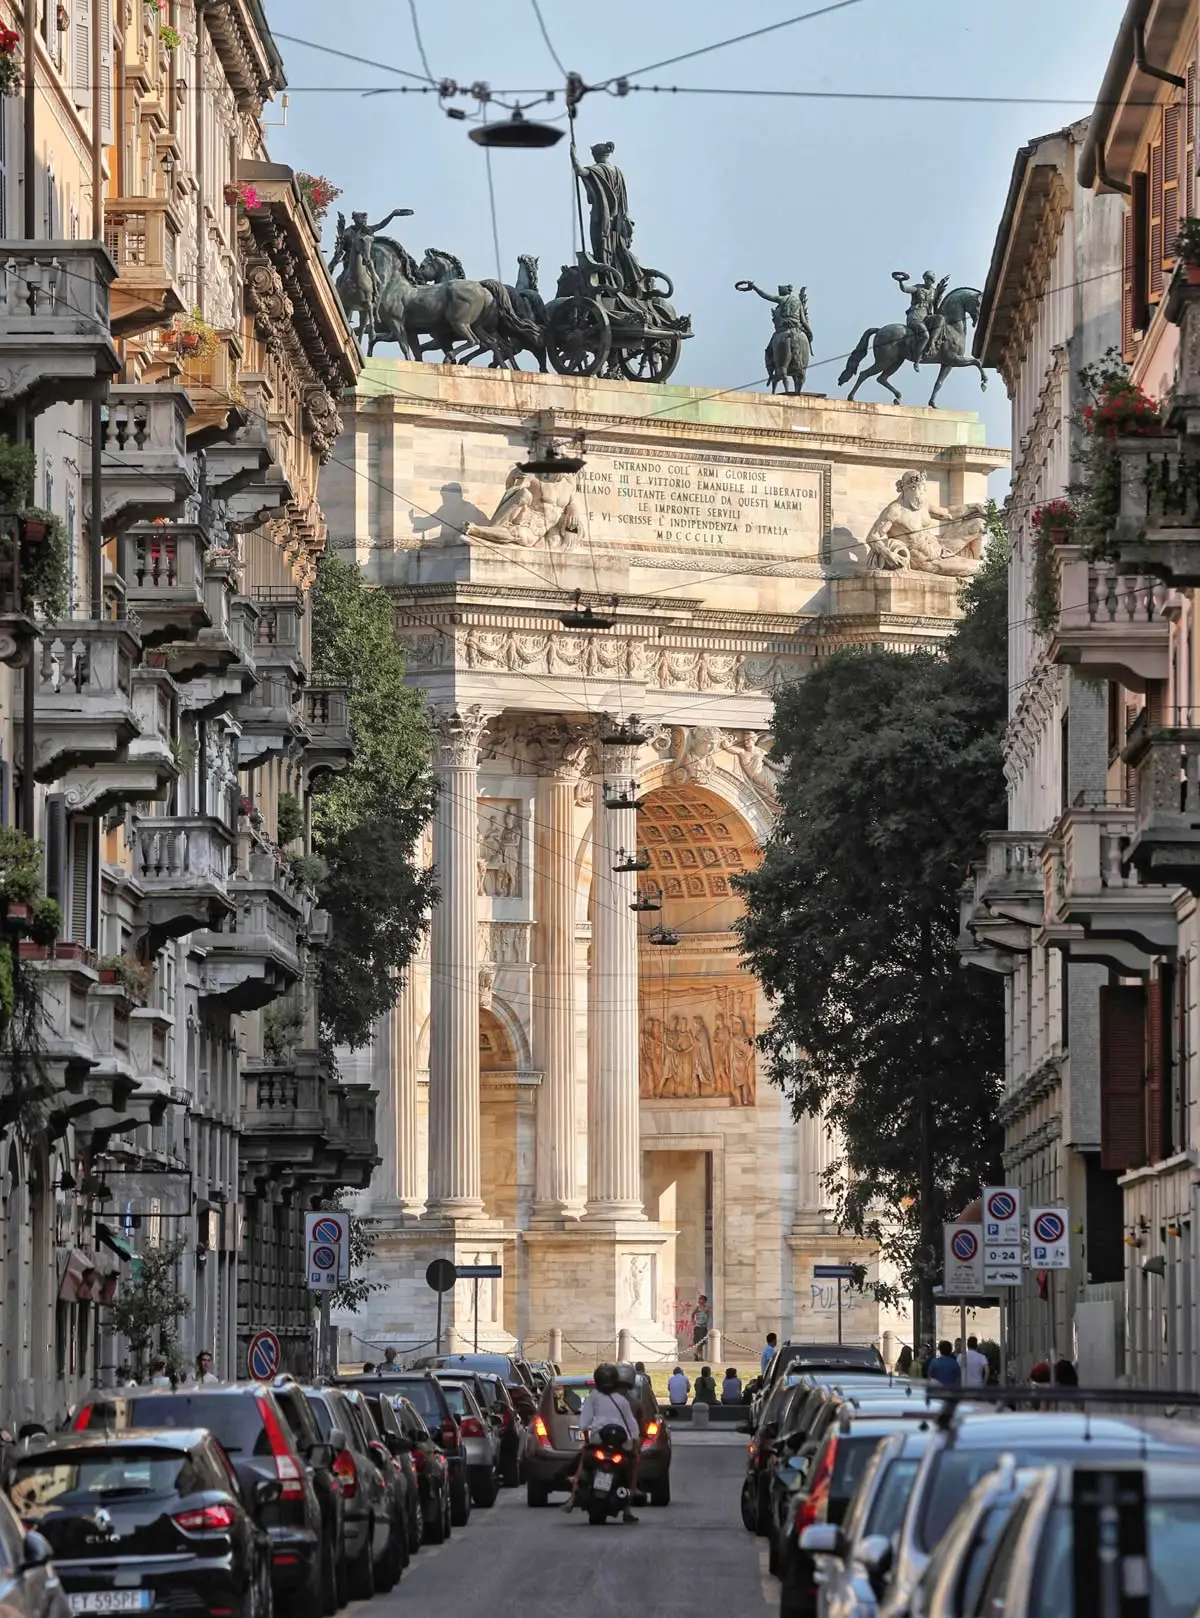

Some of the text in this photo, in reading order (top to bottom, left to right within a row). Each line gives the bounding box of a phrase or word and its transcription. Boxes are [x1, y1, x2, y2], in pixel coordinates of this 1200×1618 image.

[613, 460, 661, 473] ENTRANDO
[697, 468, 718, 478] ARMI
[726, 470, 767, 482] GLORIOSE
[577, 470, 817, 499] OLEONE III E VITTORIO EMANUELE II LIBERATORI
[576, 484, 611, 496] MILANO
[617, 487, 665, 500] ESULTANTE
[721, 495, 732, 505] DA
[738, 497, 768, 508] QUESTI
[774, 499, 802, 511] MARMI
[638, 502, 741, 519] LE IMPRONTE SERVILI
[589, 511, 594, 521] E
[602, 512, 611, 522] VI
[617, 514, 652, 526] SCRISSE
[670, 518, 738, 532] INDIPENDENZA
[758, 525, 788, 536] ITALIA
[989, 1225, 997, 1234] P
[1036, 1248, 1045, 1259] P
[85, 1534, 120, 1544] CLIO
